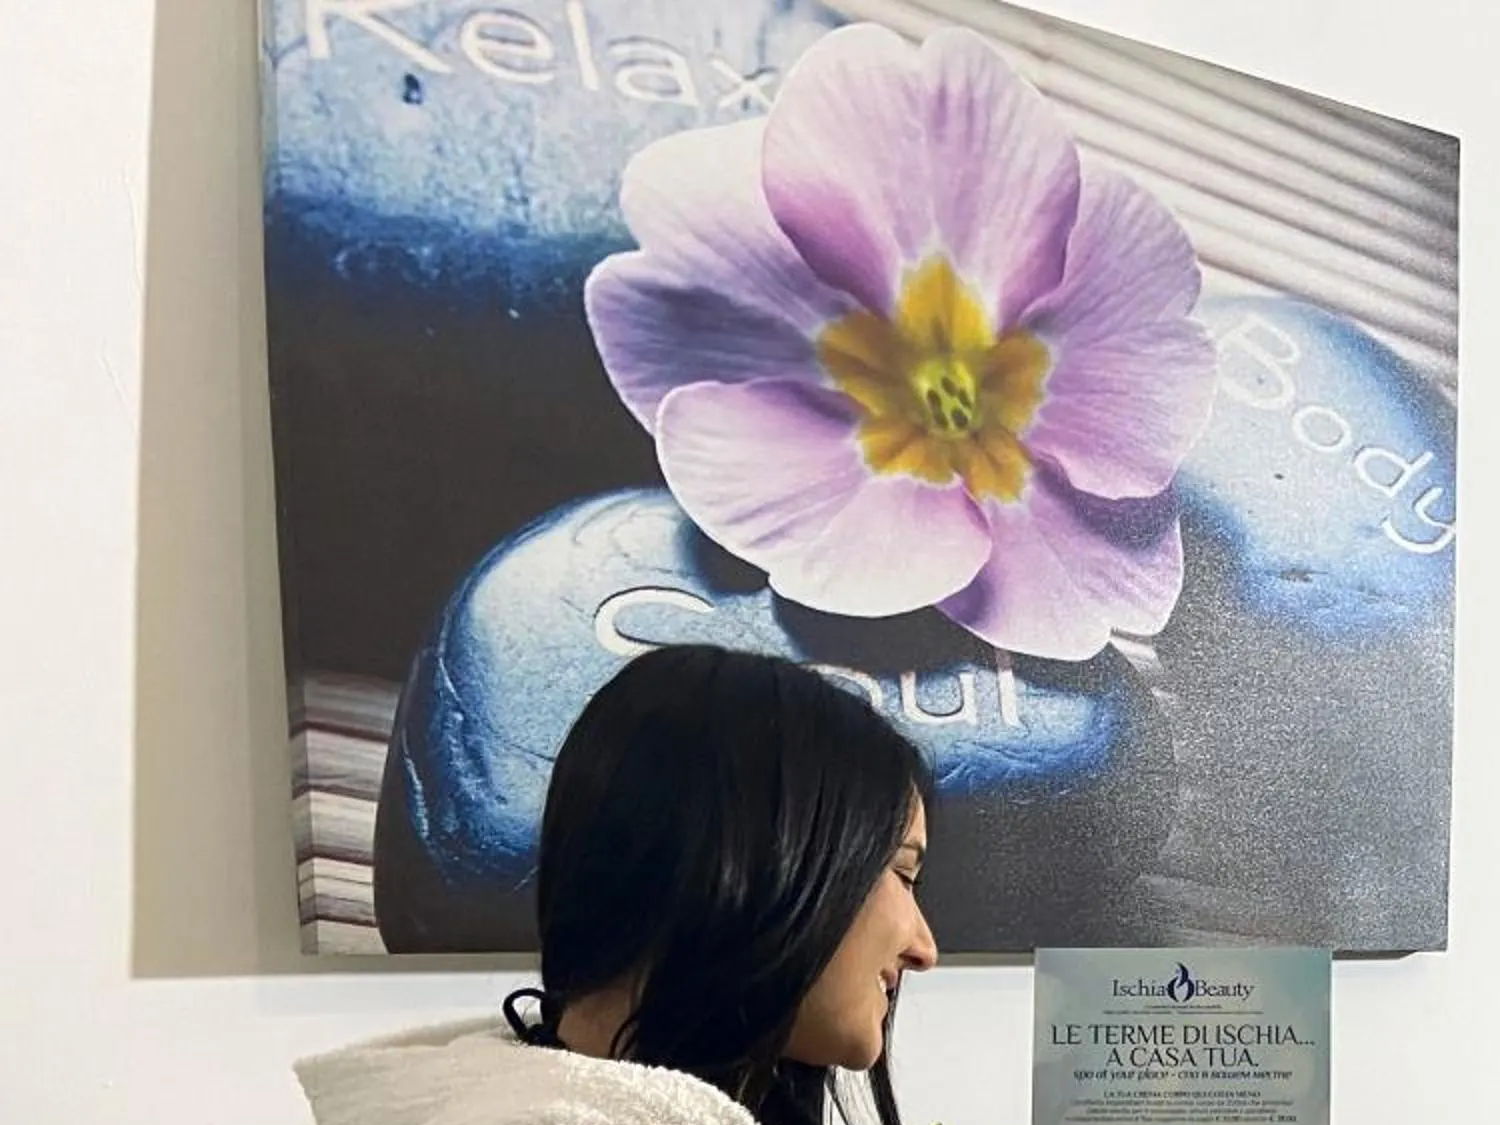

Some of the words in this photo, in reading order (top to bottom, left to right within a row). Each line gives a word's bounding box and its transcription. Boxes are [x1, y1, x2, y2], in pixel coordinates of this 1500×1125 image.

[1216, 314, 1457, 554] Body
[1112, 979, 1166, 998] Ischia
[1195, 979, 1254, 1000] Beauty
[1051, 1024, 1082, 1045] LE
[1087, 1024, 1174, 1045] TERME
[1183, 1024, 1209, 1045] DI
[1105, 1048, 1123, 1067] A
[1129, 1047, 1198, 1068] CASA
[1204, 1047, 1261, 1068] TUA.
